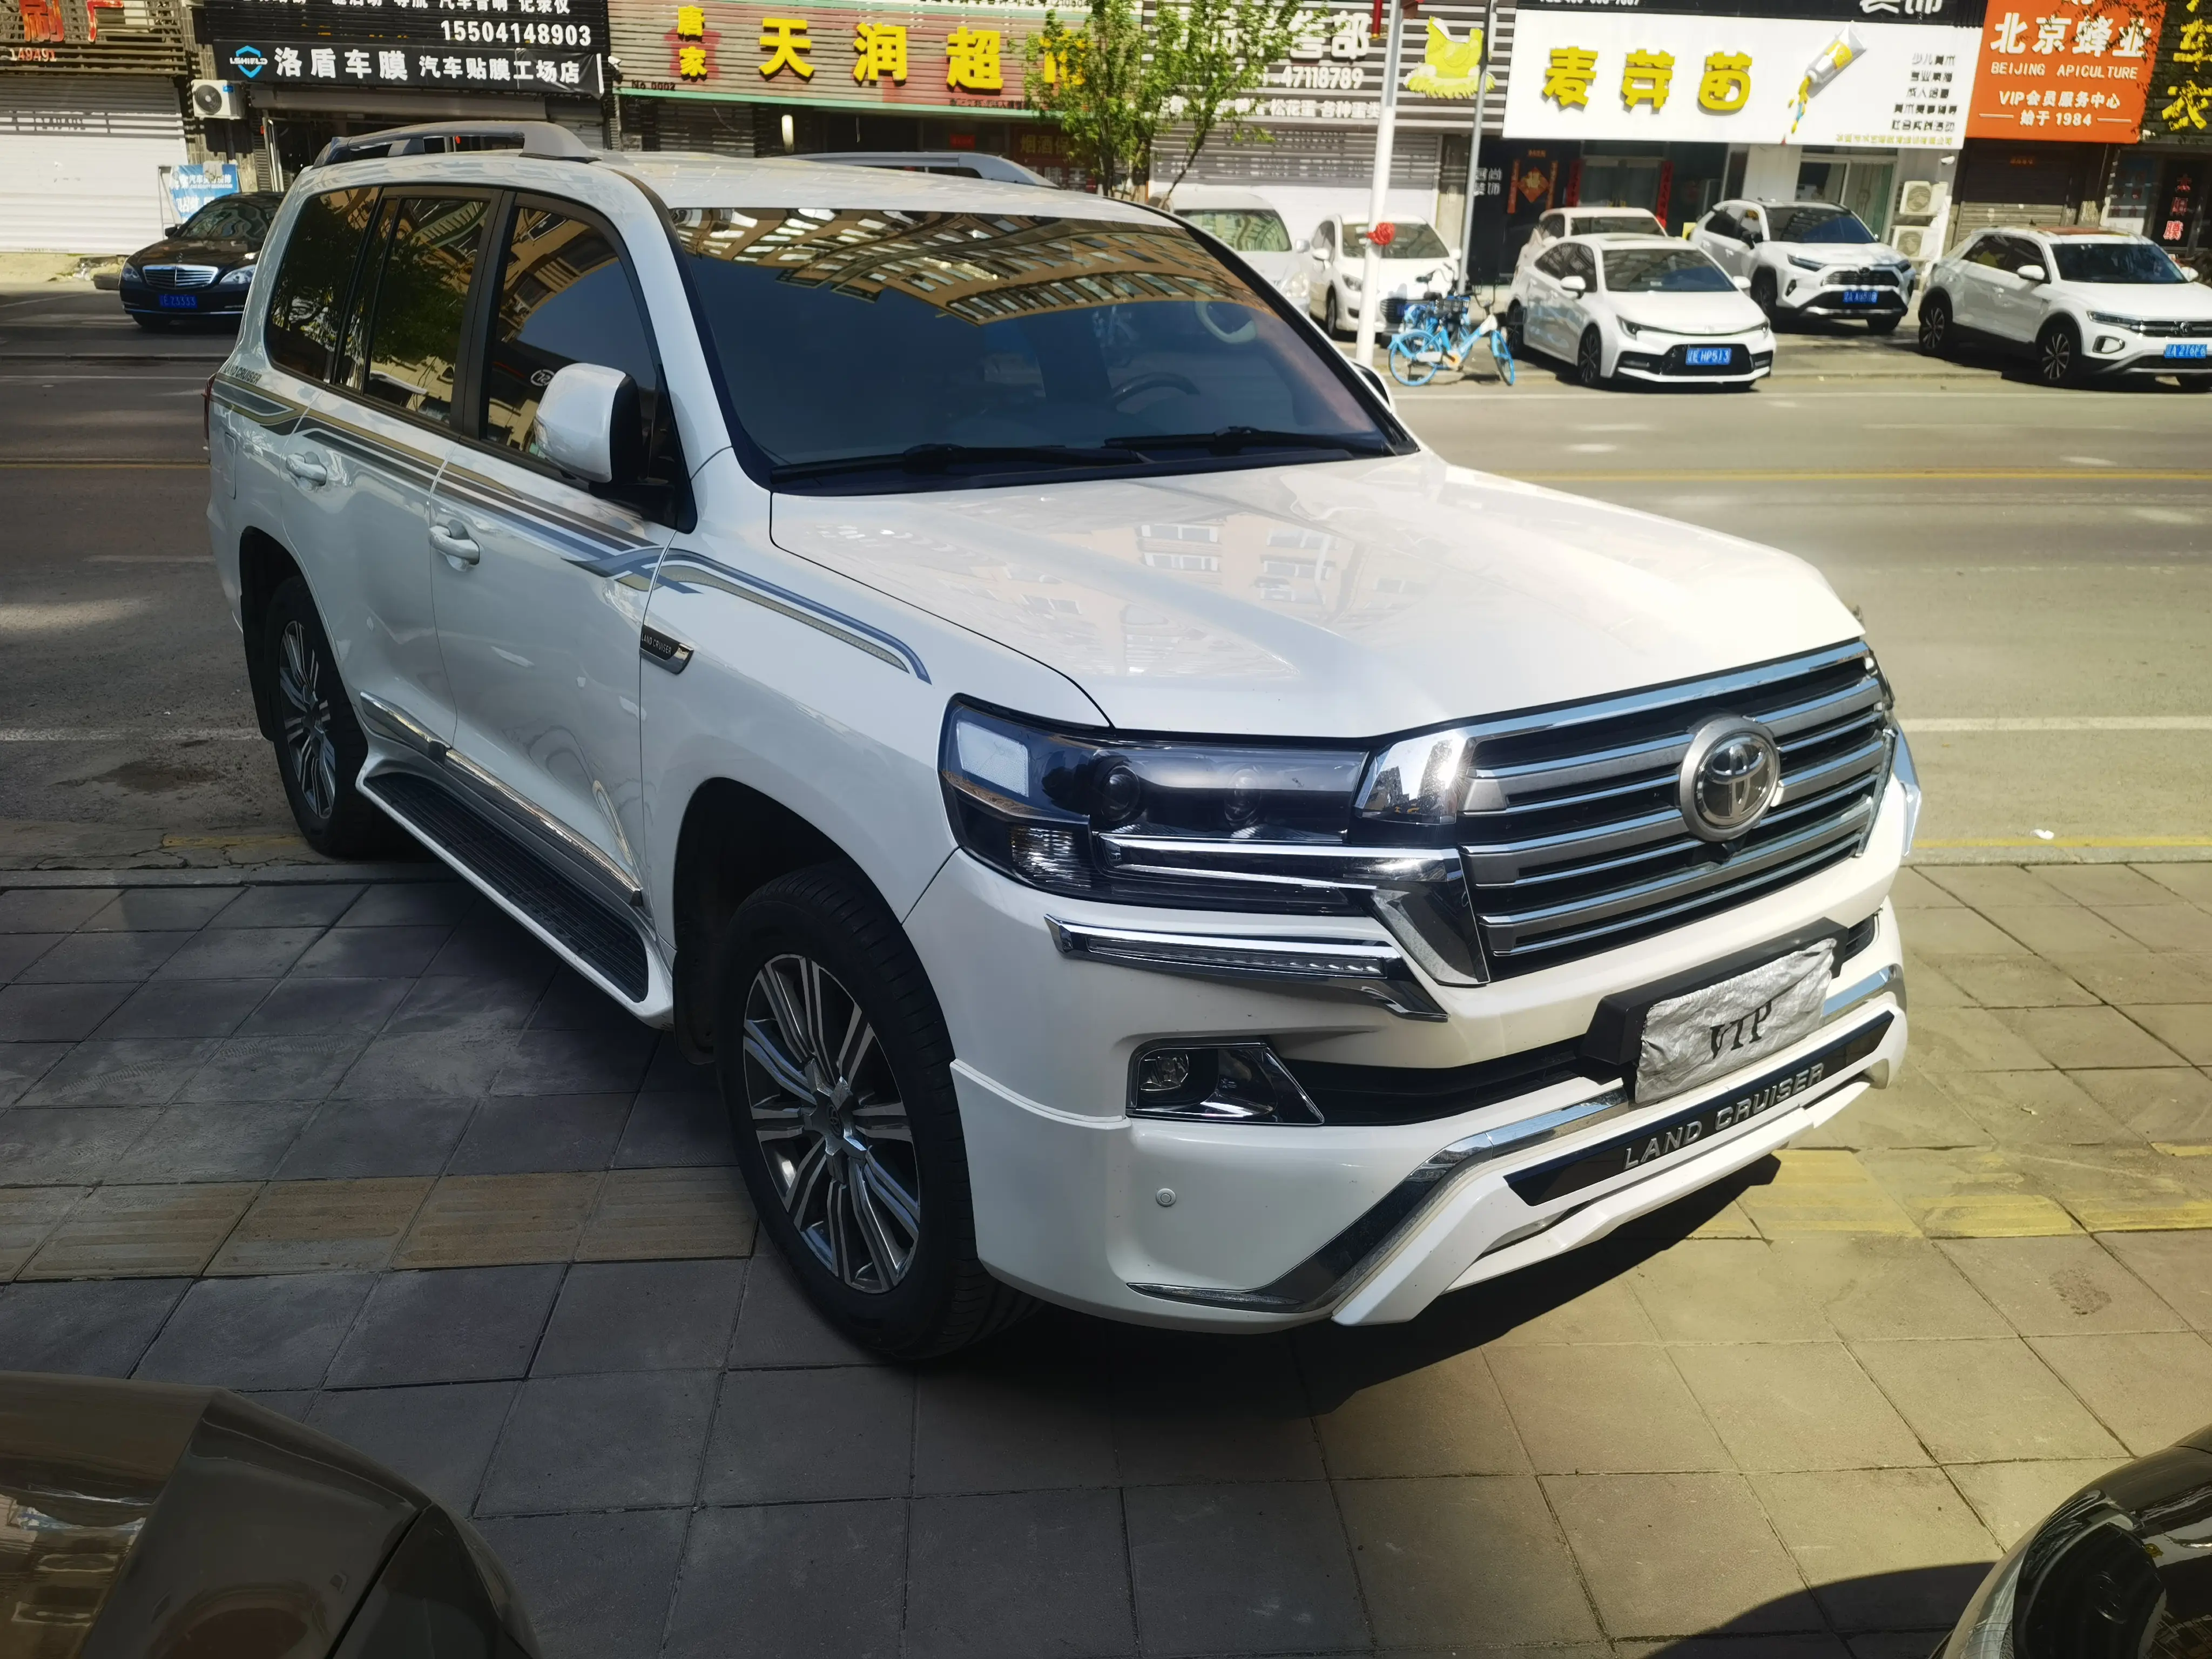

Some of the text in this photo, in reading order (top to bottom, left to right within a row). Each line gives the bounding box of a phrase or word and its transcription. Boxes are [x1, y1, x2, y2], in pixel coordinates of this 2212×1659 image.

[441, 20, 591, 46] 15504148903
[677, 5, 707, 78] 唐家
[1991, 12, 2152, 58] 北京蜂业
[274, 47, 408, 80] 洛盾车膜
[419, 55, 579, 83] 汽车贴膜工场店
[1991, 62, 2139, 79] BEIJING APICULTURE
[1999, 90, 2121, 109] VIP会员服务中心
[2020, 110, 2092, 127] 始于 1984
[235, 367, 262, 385] CRUISER
[641, 633, 672, 655] LAND CRUISER
[1709, 1001, 1772, 1059] VIP
[1623, 1062, 1826, 1171] LAND CRUISER
